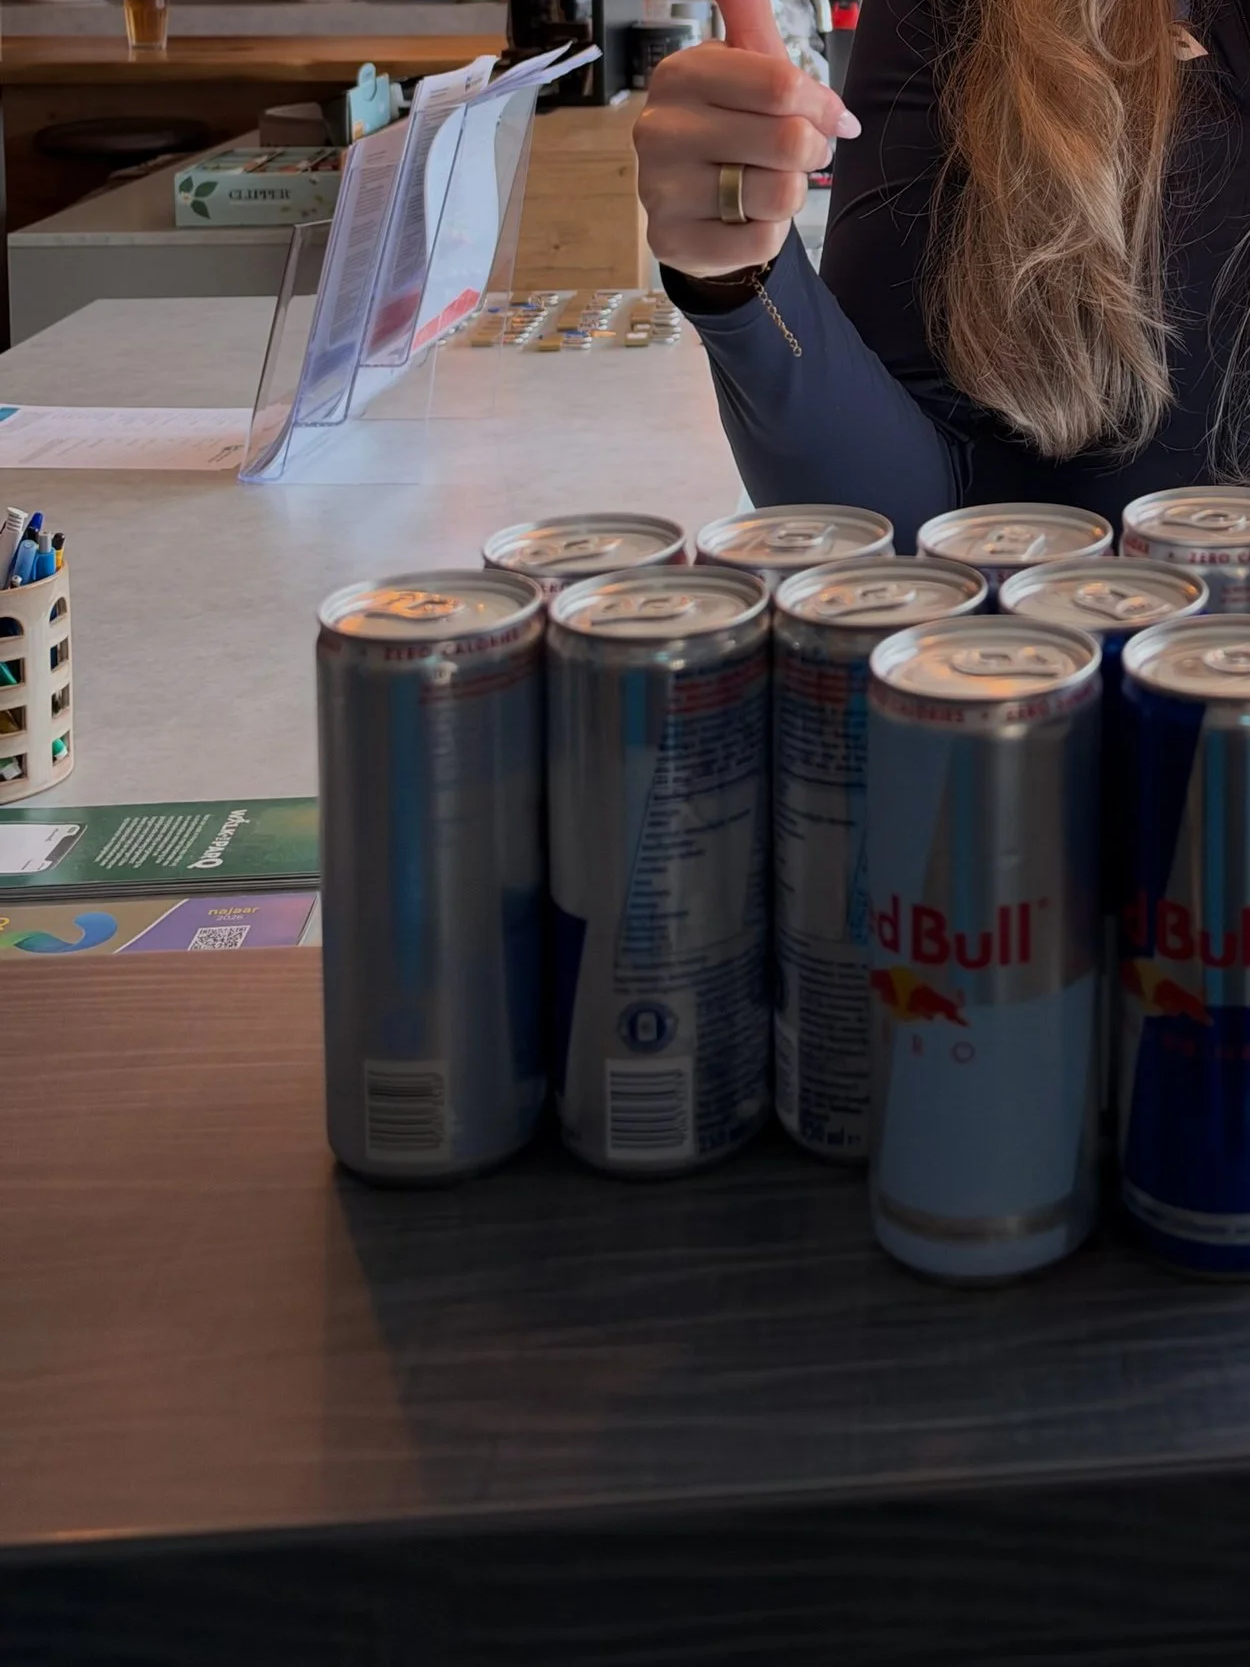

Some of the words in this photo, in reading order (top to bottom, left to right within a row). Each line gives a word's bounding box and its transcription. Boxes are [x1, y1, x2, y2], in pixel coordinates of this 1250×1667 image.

[229, 188, 292, 200] CLIPPER
[1188, 551, 1230, 565] ZERO
[207, 906, 260, 916] najaar
[911, 901, 1032, 970] Bull
